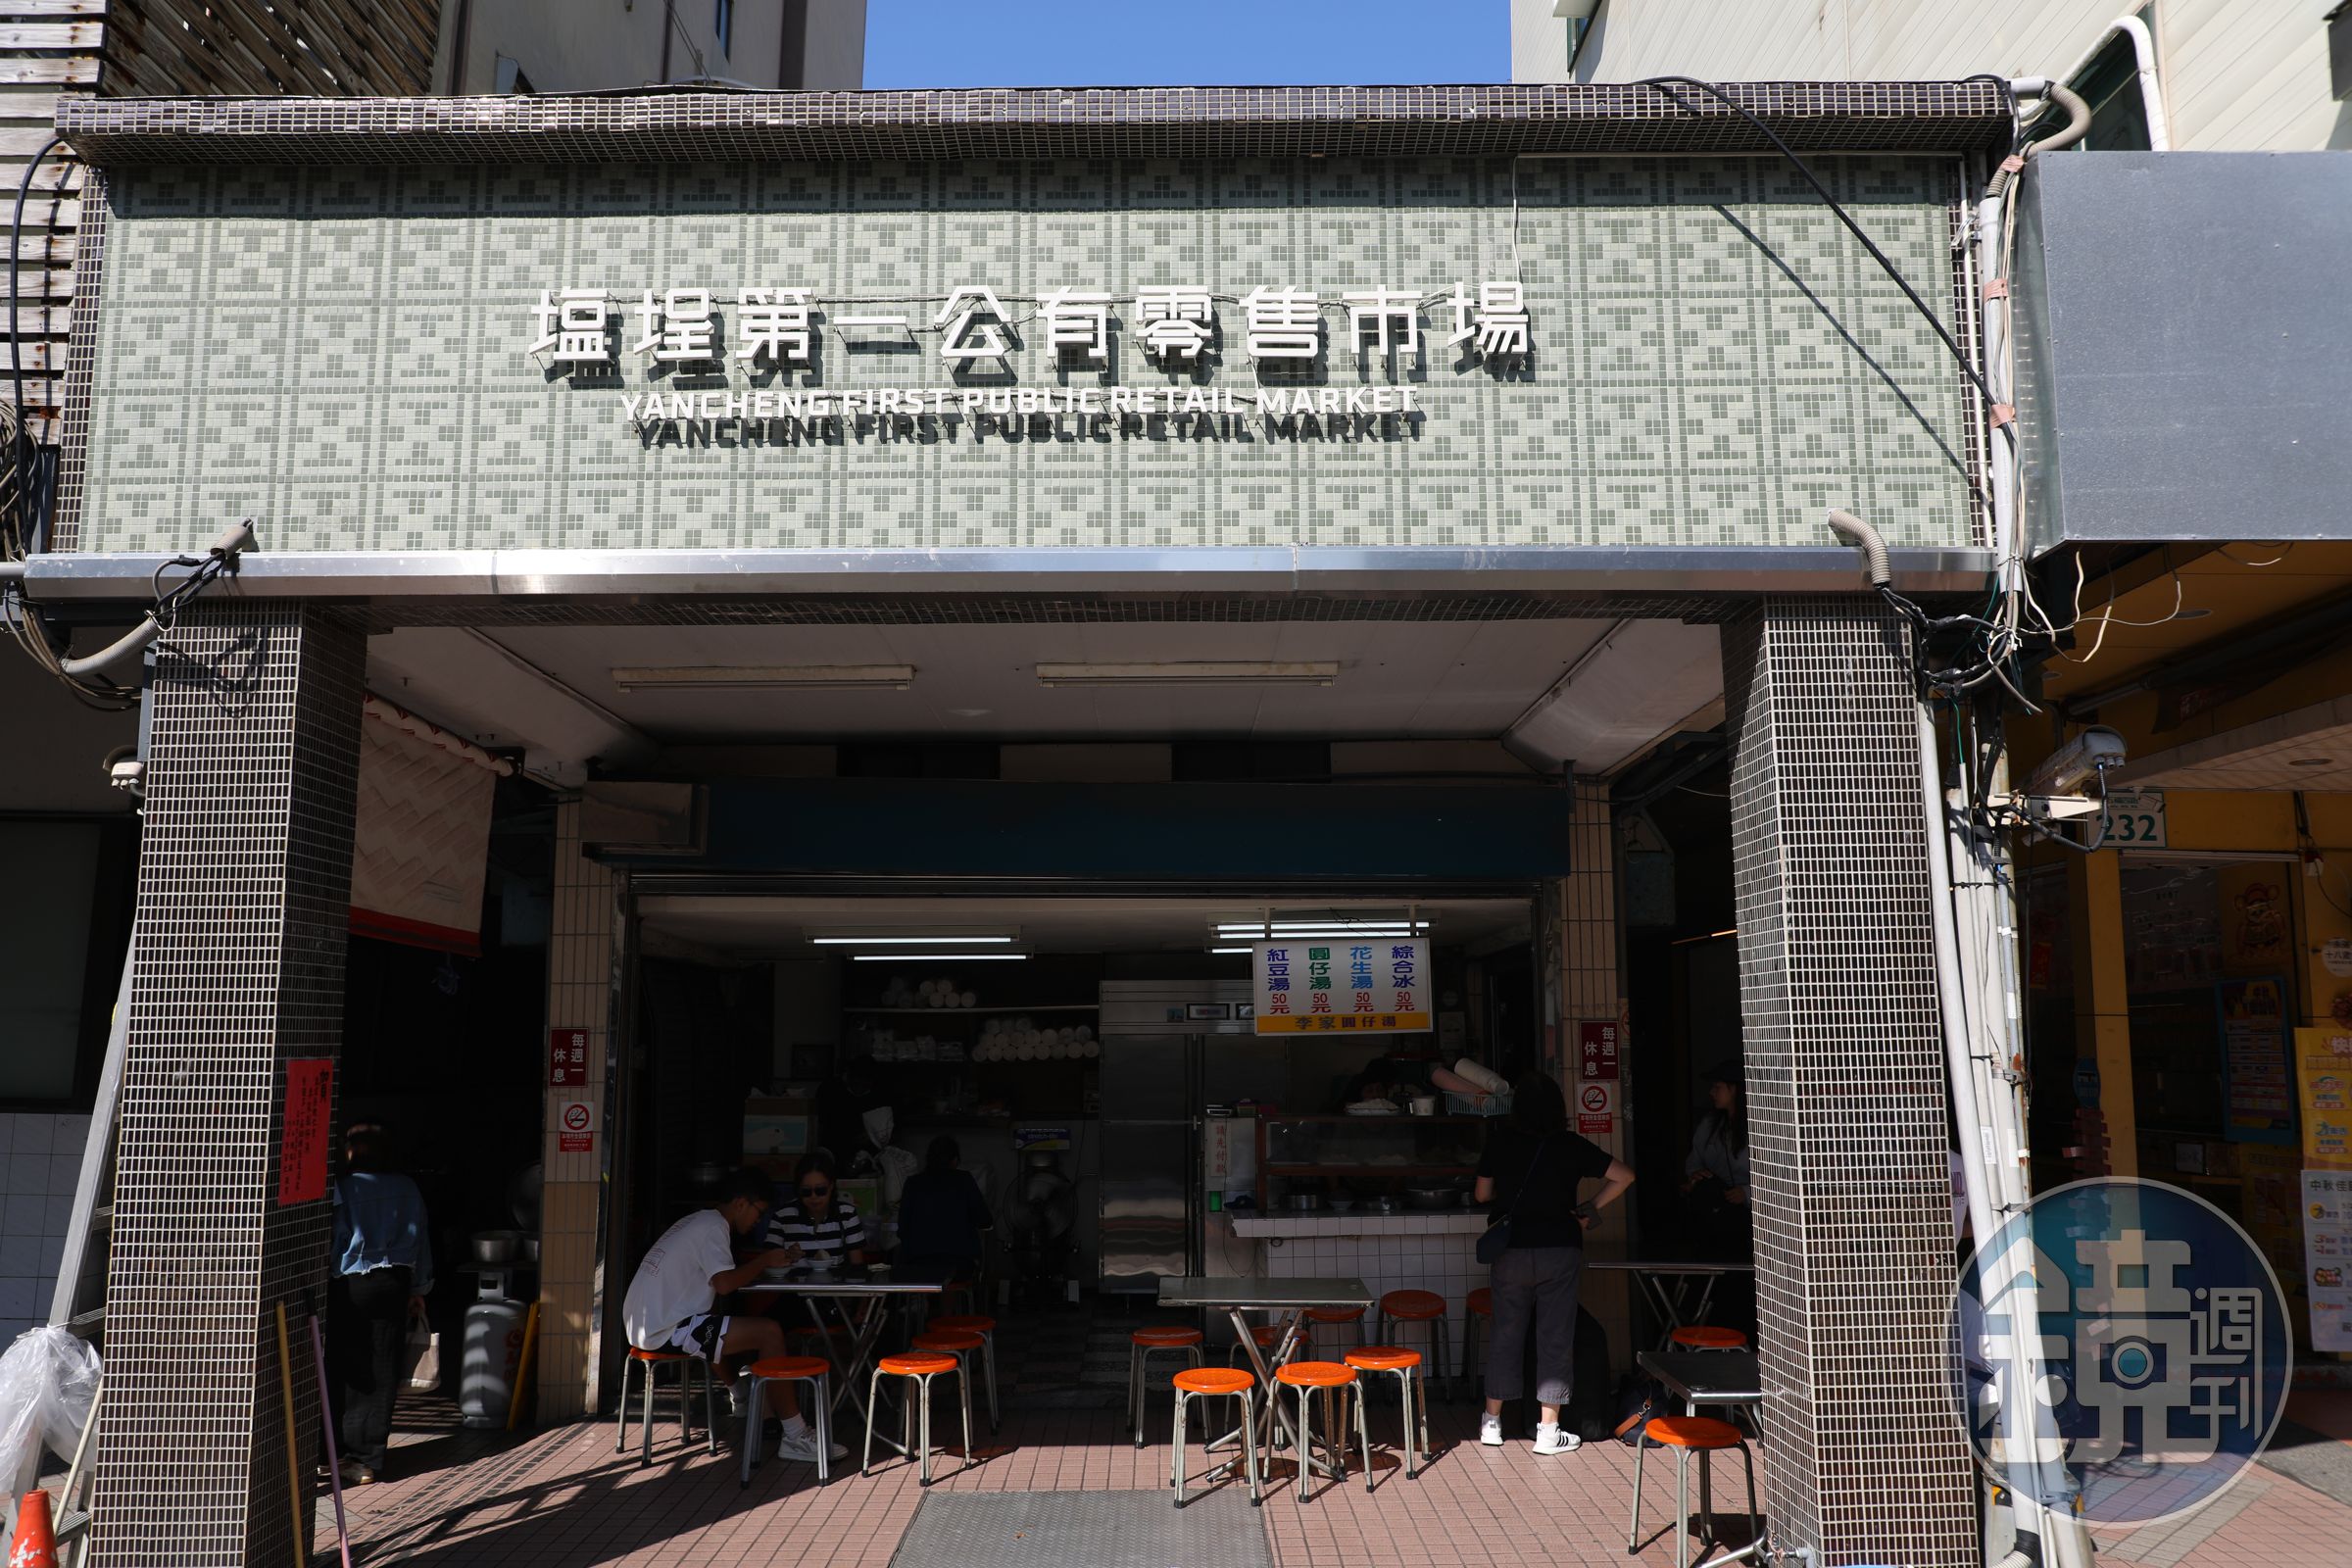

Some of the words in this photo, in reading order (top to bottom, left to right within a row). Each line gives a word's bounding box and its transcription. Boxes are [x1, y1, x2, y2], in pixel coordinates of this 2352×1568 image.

[620, 391, 830, 421] YANCHENG
[842, 388, 956, 416] FIRST
[962, 387, 1101, 416] PUBLIC
[1109, 386, 1243, 415] RETAIL
[1256, 386, 1418, 415] MARKET
[2096, 814, 2157, 841] 232
[1267, 949, 1290, 992] 紅豆湯
[1308, 947, 1332, 990] 圓仔湯
[1349, 946, 1373, 989] 花生湯
[1392, 946, 1415, 989] 綜合冰
[570, 1033, 585, 1072] 每週一
[1584, 1041, 1598, 1076] 休息
[1601, 1026, 1616, 1065] 每週一
[552, 1048, 566, 1083] 休息
[2310, 1180, 2352, 1192] 中秋佳
